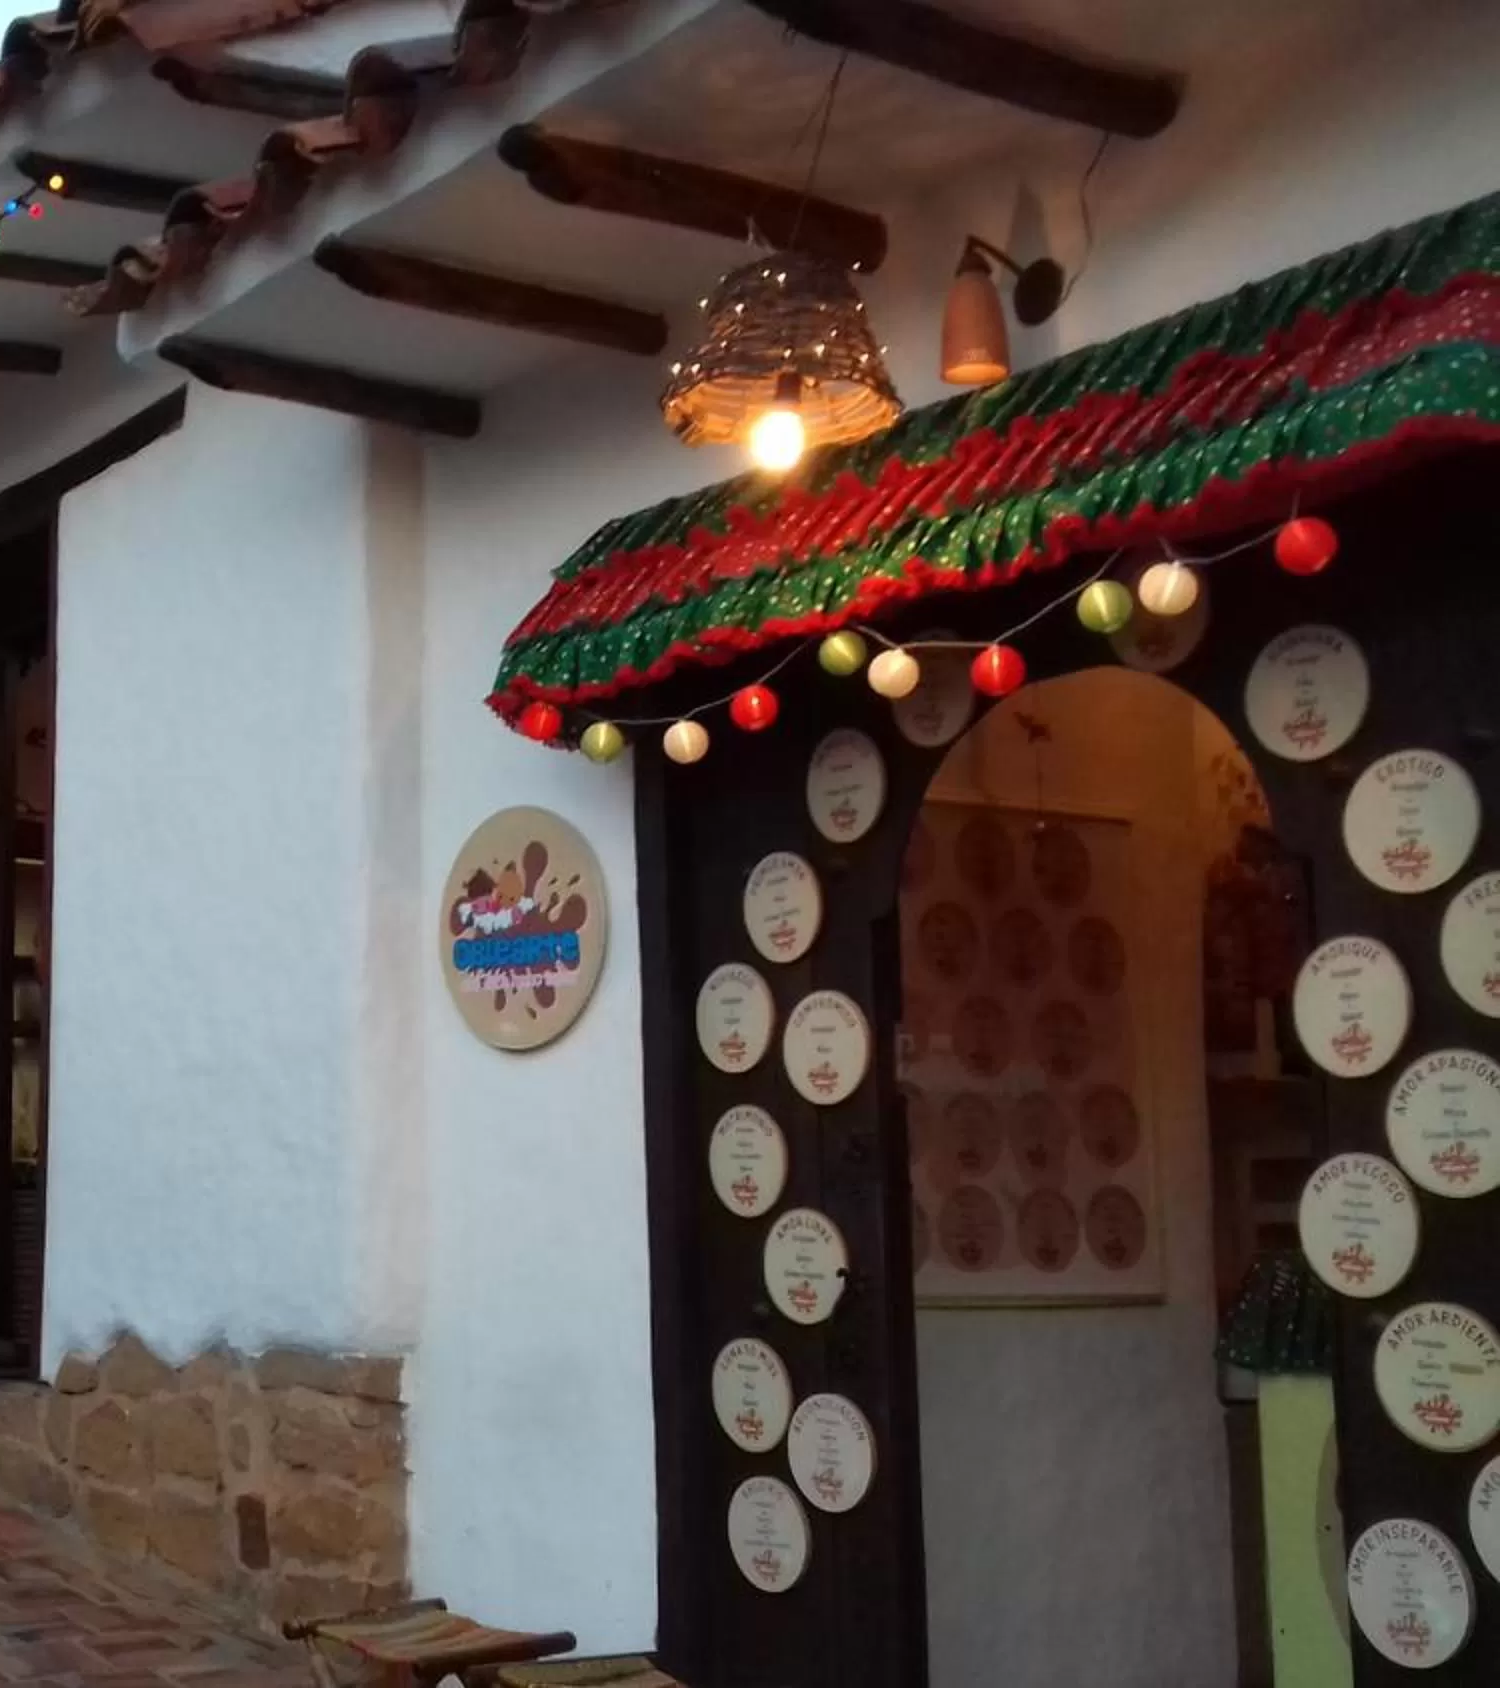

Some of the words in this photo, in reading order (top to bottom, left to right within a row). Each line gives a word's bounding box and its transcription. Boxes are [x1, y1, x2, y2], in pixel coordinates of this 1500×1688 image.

[1393, 1069, 1426, 1116] AMOR
[1312, 1160, 1349, 1196] AMOR
[1387, 1312, 1425, 1351] AMOR
[1350, 1535, 1376, 1586] AMOR
